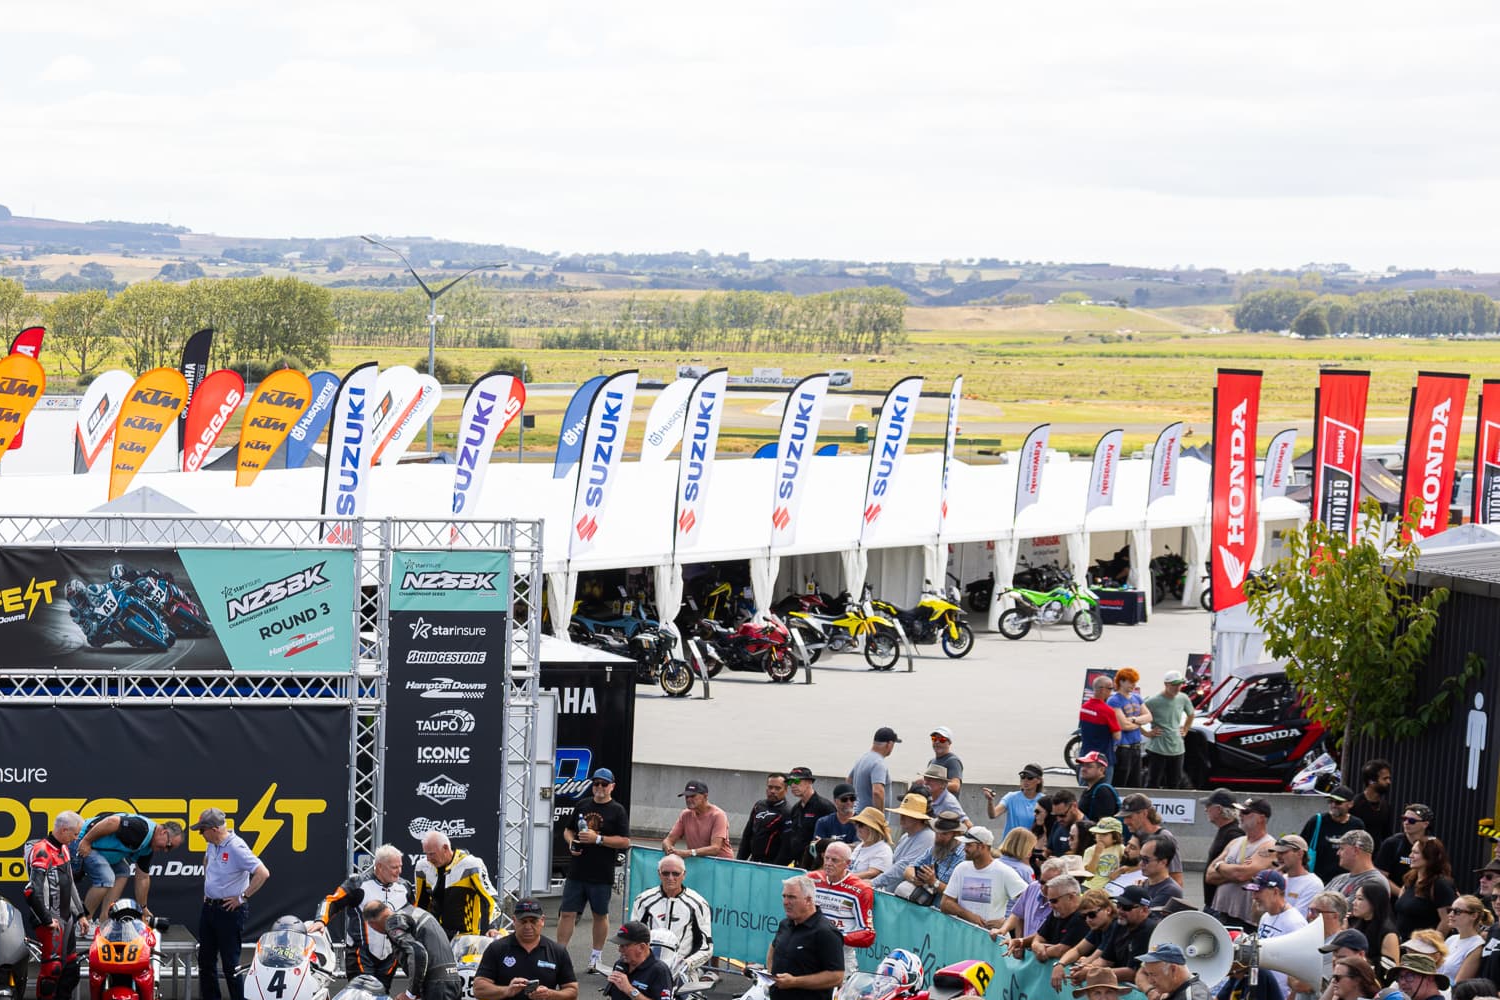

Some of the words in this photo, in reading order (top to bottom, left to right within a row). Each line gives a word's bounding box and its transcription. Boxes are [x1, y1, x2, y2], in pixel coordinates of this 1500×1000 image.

[131, 387, 182, 411] KTM
[256, 389, 305, 410] KTM
[303, 379, 334, 432] Husqvarna
[123, 415, 163, 433] KTM
[186, 388, 241, 471] GASGAS
[249, 416, 287, 432] KTM
[118, 441, 147, 454] KTM
[244, 439, 272, 452] KTM
[336, 387, 366, 516] SUZUKI
[453, 390, 498, 514] SUZUKI
[586, 391, 624, 507] SUZUKI
[684, 391, 717, 502] SUZUKI
[780, 393, 816, 500] SUZUKI
[873, 395, 909, 496] SUZUKI
[1337, 430, 1348, 465] Honda
[115, 463, 135, 471] KTM
[240, 460, 259, 468] KTM
[1029, 441, 1043, 494] Kawasaki
[1101, 443, 1115, 496] Kawasaki
[1162, 437, 1176, 487] Kawasaki
[1227, 397, 1248, 547] HONDA
[1272, 441, 1288, 488] Kawasaki
[1419, 397, 1452, 530] HONDA
[1332, 480, 1350, 531] GENUIN
[227, 560, 330, 622] NZSBK
[232, 578, 262, 594] starinsure
[400, 570, 500, 591] NZSBK
[229, 611, 263, 630] CHAMPIONSHIP
[263, 606, 279, 615] SERIES
[259, 608, 317, 640] ROUND
[319, 603, 331, 616] 3
[432, 624, 486, 636] starinsure
[268, 637, 306, 657] Hampton
[306, 626, 335, 642] Downs
[406, 650, 487, 664] BRIDGESTONE
[405, 680, 451, 691] Hampton
[451, 681, 487, 690] Downs
[1240, 728, 1302, 745] HONDA
[417, 747, 471, 760] ICONIC
[415, 781, 466, 796] Putoline
[431, 819, 466, 831] RACE
[710, 904, 779, 934] rinsure
[267, 969, 287, 999] 4
[976, 966, 990, 990] R
